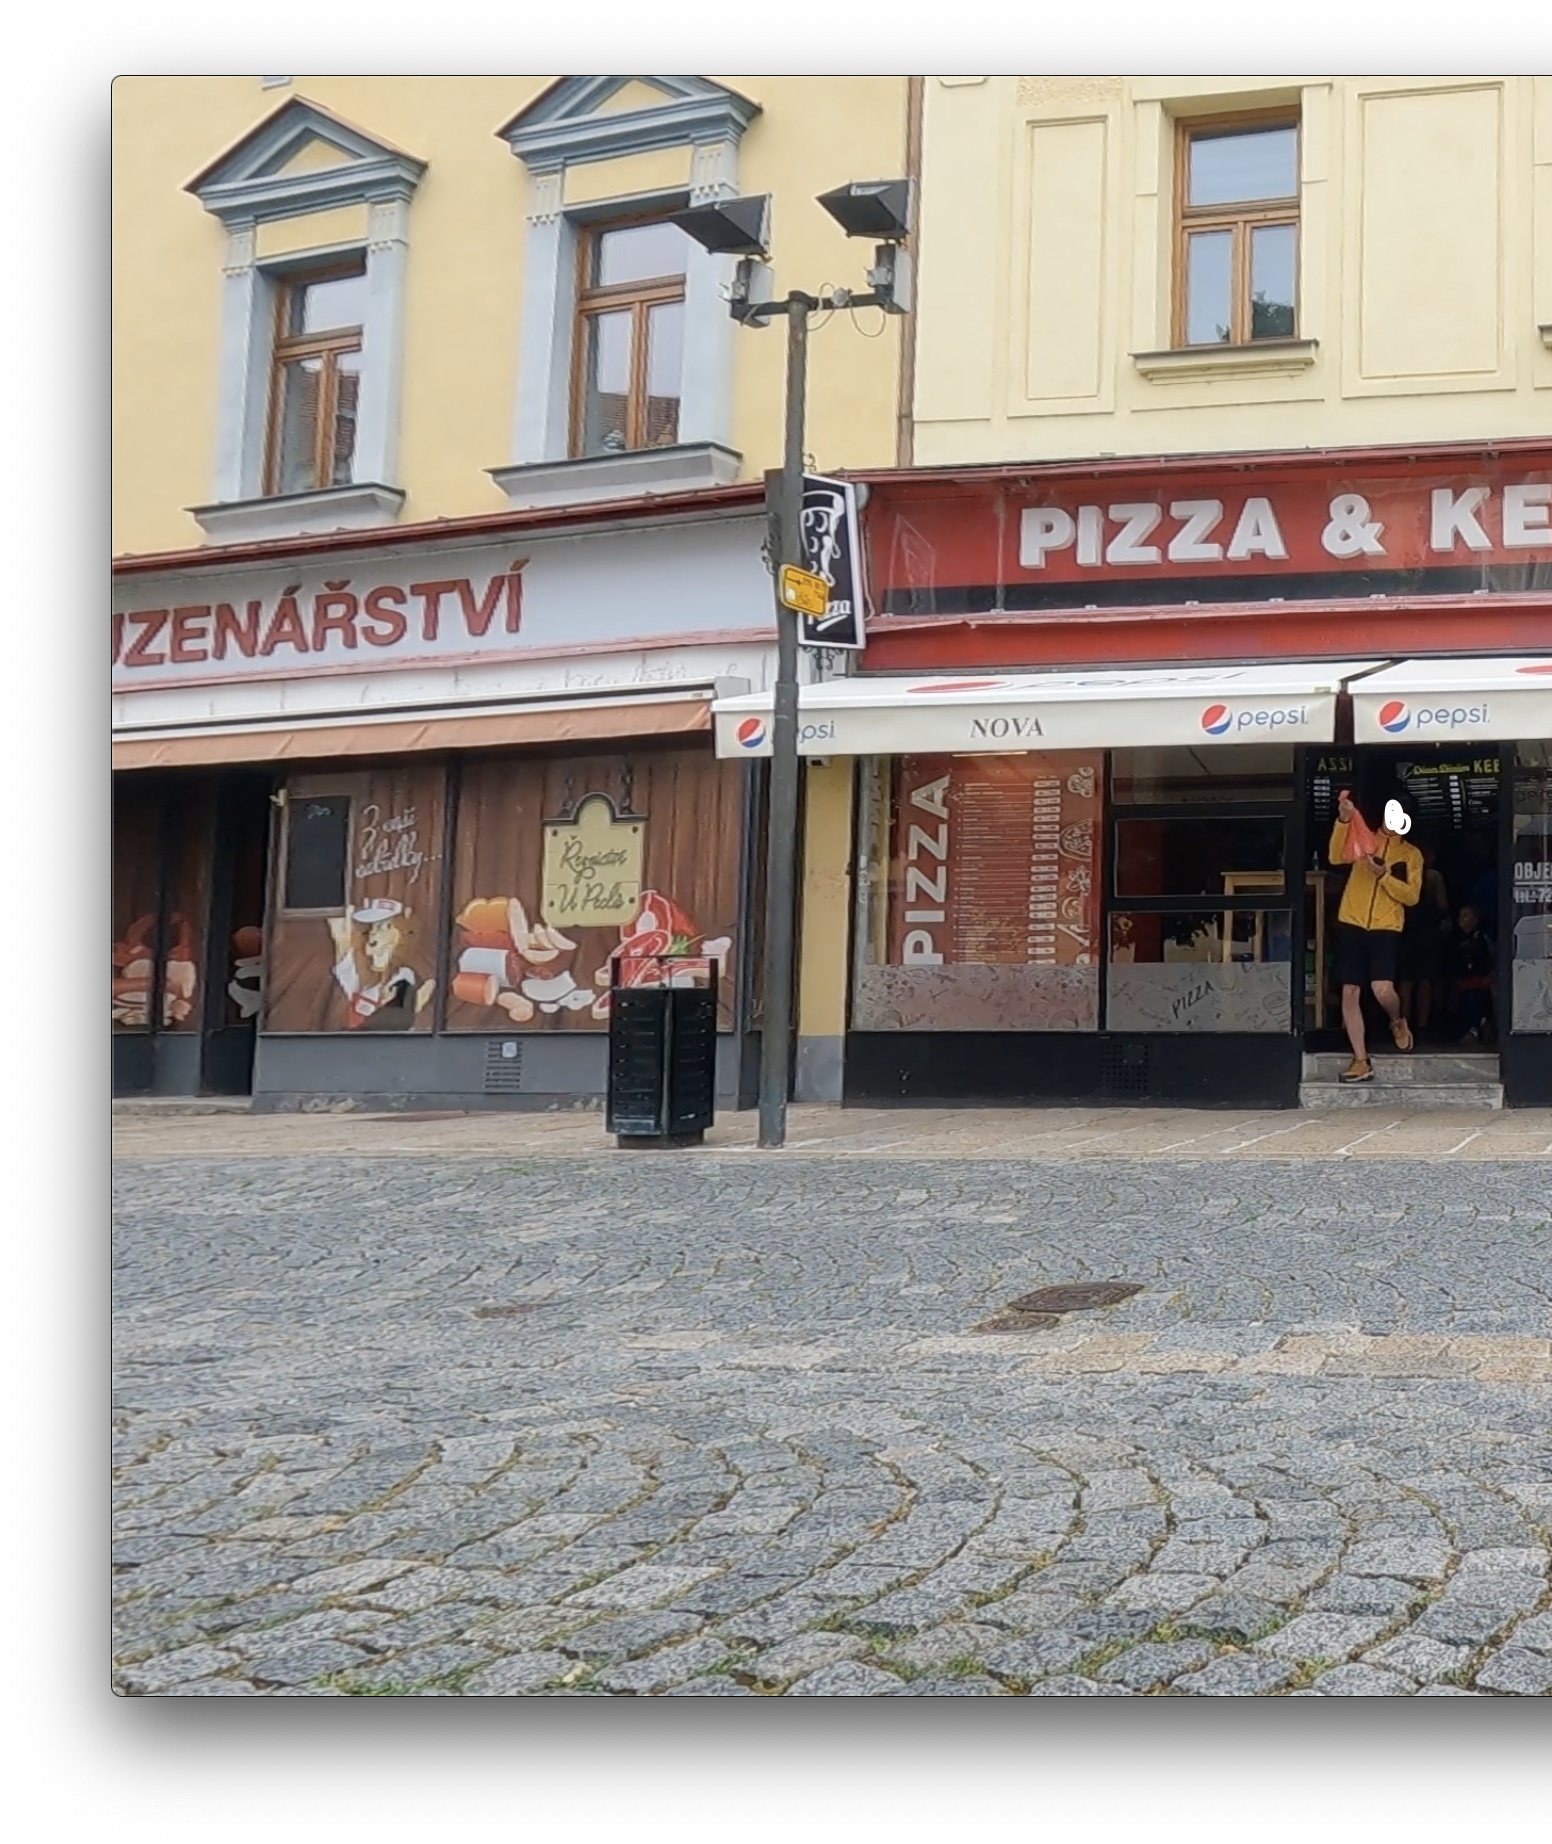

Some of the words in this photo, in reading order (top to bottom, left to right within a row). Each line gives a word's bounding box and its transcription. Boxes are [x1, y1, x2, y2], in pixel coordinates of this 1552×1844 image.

[1020, 497, 1288, 568] PIZZA
[1321, 493, 1387, 560] &
[970, 716, 1044, 739] NOVA
[1237, 705, 1307, 732] pepsi
[1416, 703, 1489, 729] pepsi
[800, 720, 836, 744] psi
[903, 774, 950, 965] PIZZA
[1171, 979, 1215, 1019] PIZZA
